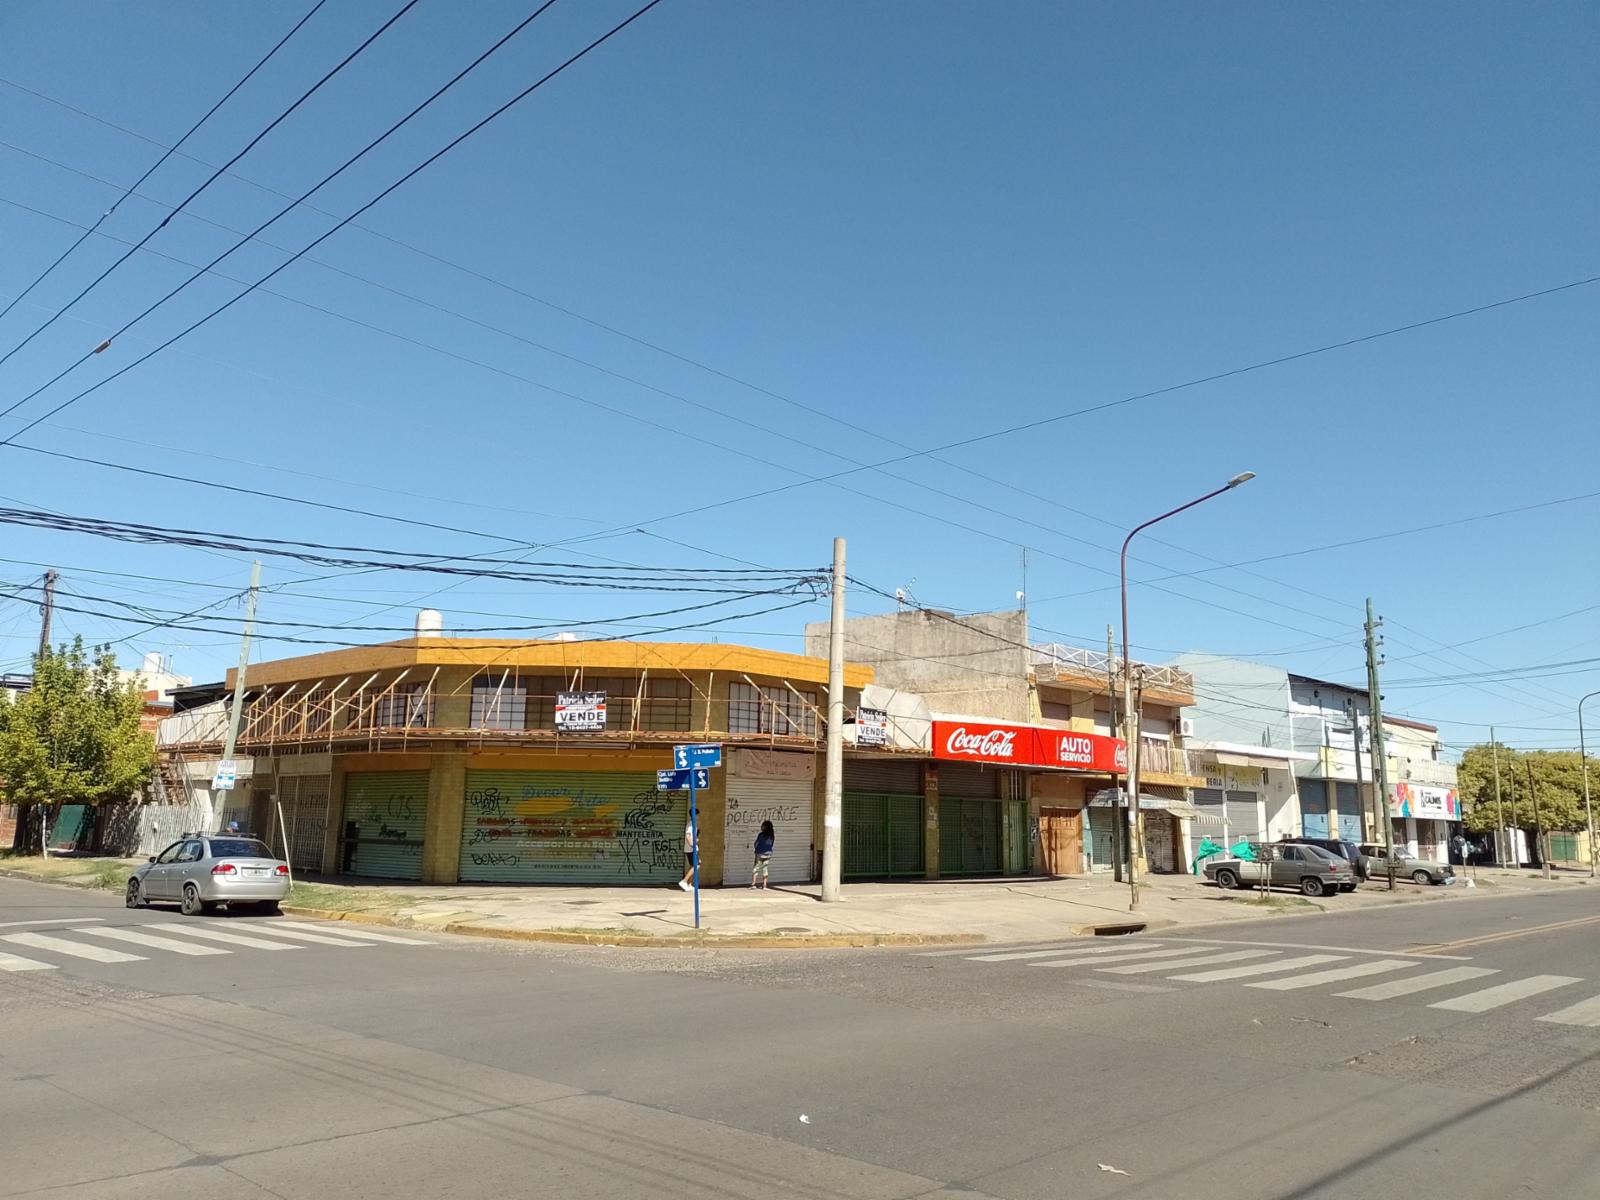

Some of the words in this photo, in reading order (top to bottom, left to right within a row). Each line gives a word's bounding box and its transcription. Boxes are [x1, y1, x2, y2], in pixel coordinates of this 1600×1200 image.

[560, 711, 604, 722] VENDE
[860, 726, 886, 737] VENDE
[947, 728, 1016, 757] Coca-Cola
[1060, 736, 1091, 754] AUTO
[1060, 751, 1091, 764] SERVICIO
